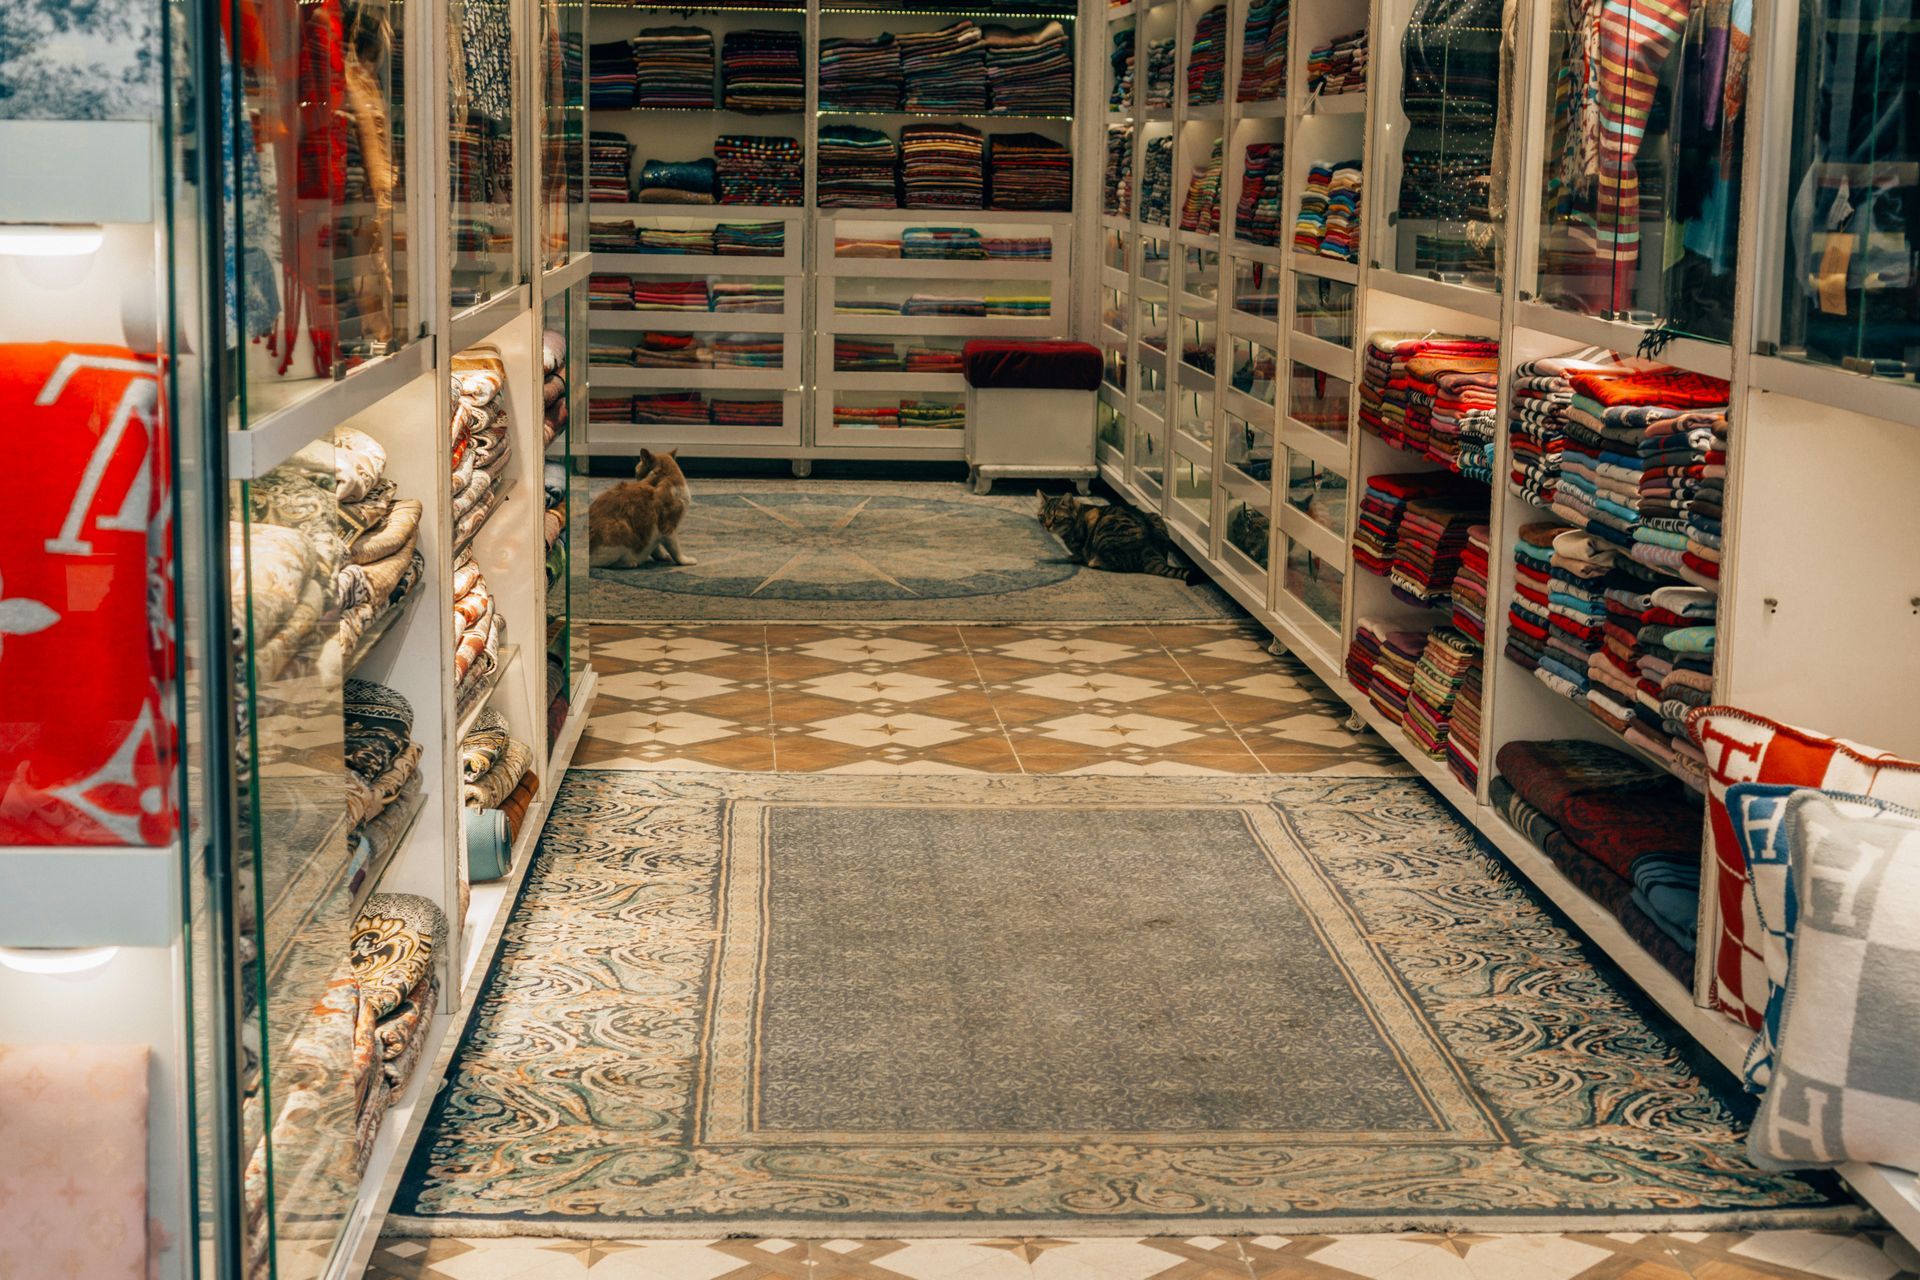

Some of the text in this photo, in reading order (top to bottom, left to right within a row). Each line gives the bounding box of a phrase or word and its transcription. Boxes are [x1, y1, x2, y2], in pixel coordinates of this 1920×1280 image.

[1702, 720, 1763, 787] H
[1741, 795, 1790, 859] H
[1803, 820, 1885, 927] H
[1769, 1072, 1829, 1162] H
